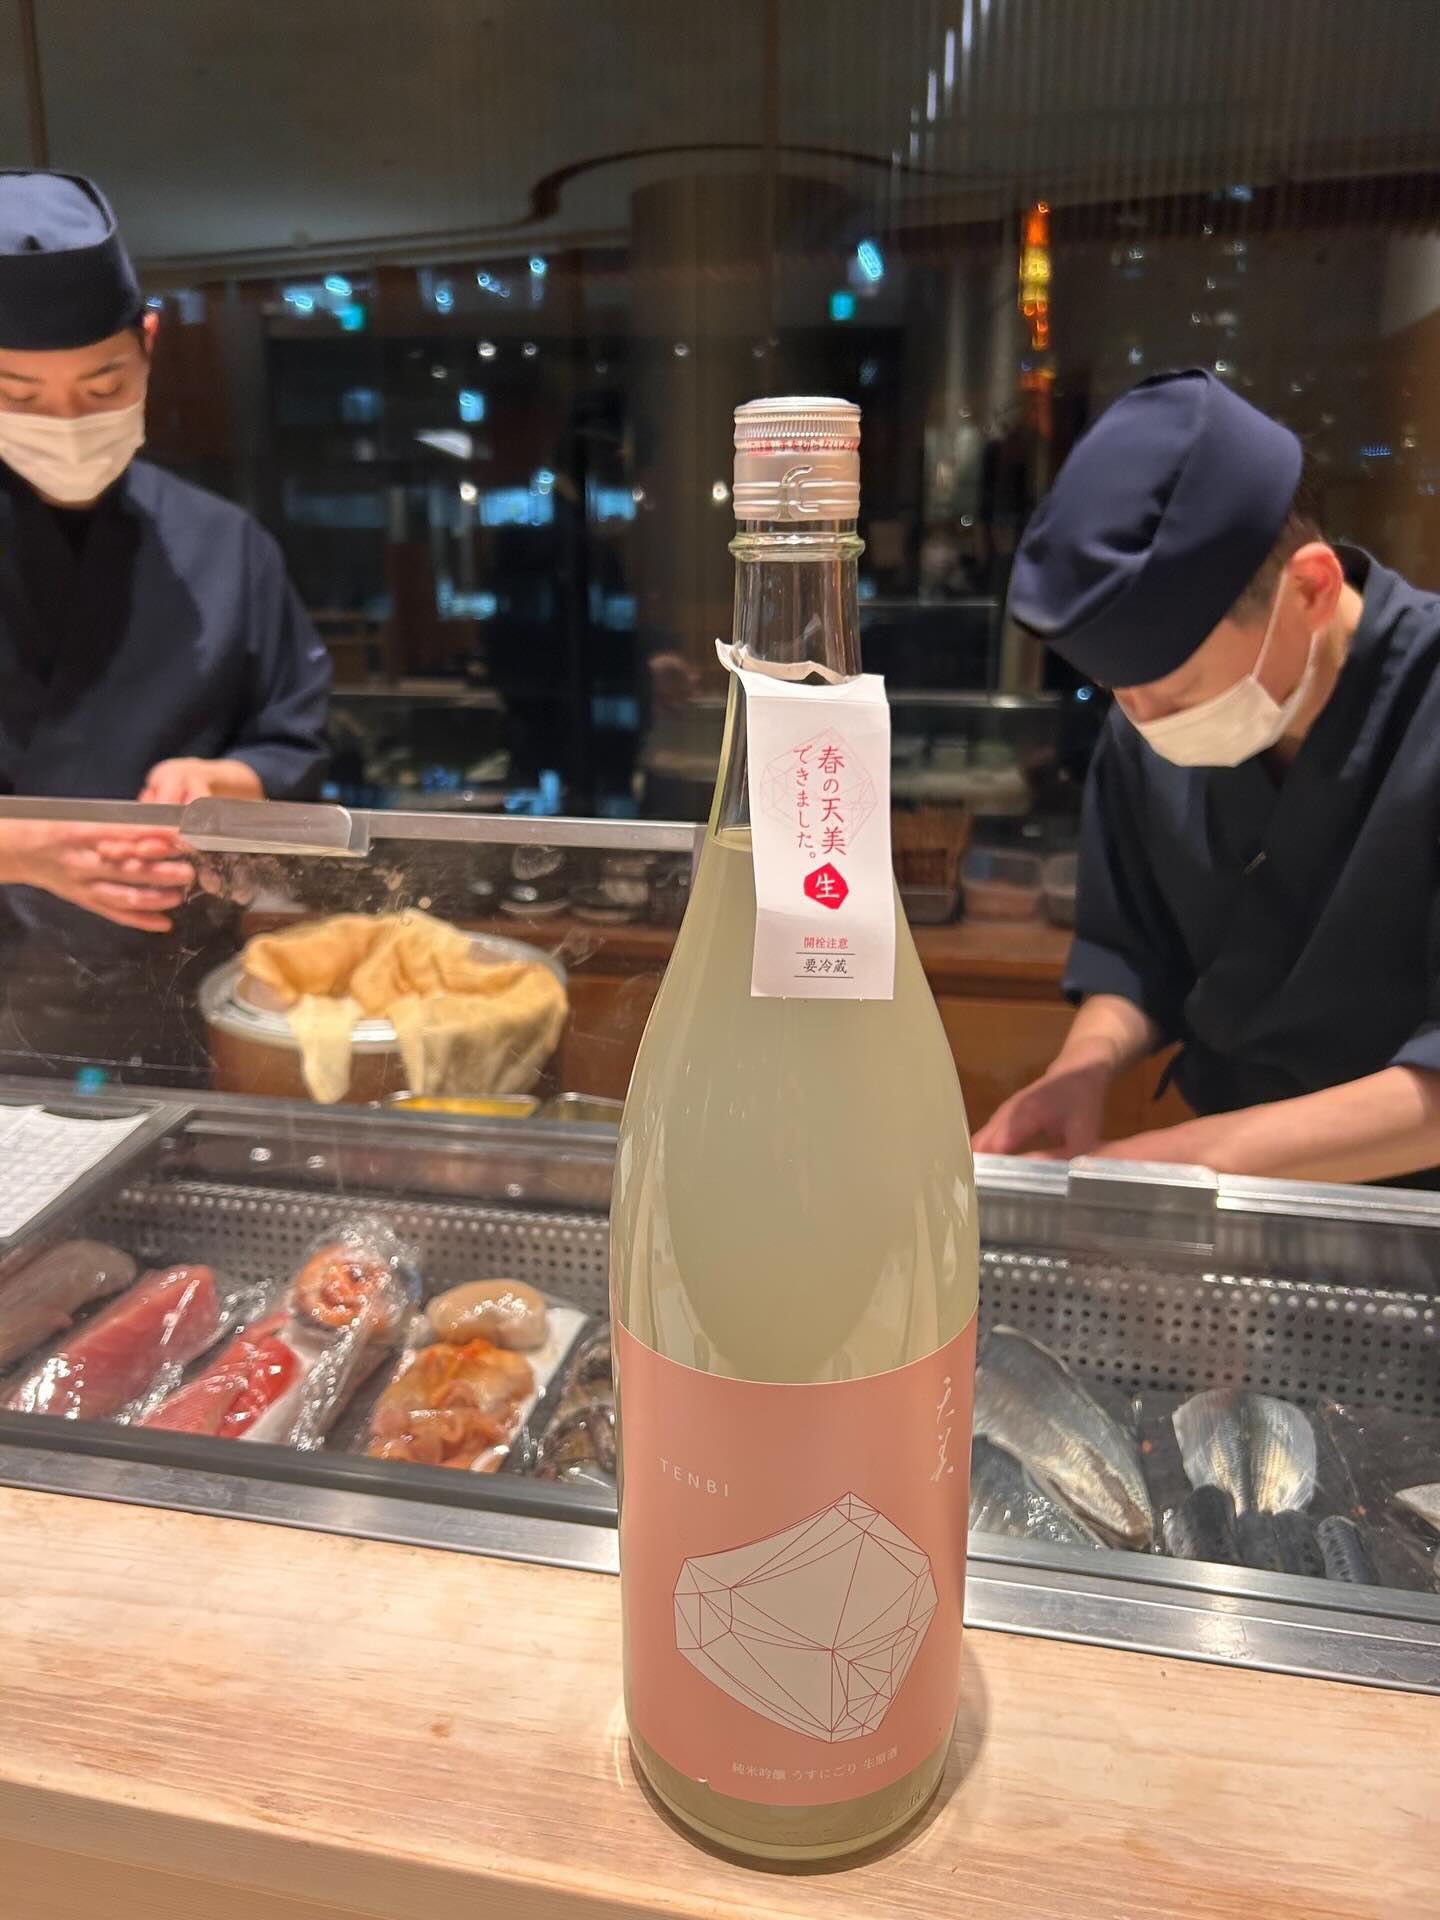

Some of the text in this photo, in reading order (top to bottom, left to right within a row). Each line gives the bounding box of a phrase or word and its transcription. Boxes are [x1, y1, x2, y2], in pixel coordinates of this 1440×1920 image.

[793, 745, 816, 859] できました。
[818, 745, 847, 856] 春の天美
[815, 872, 840, 899] 生
[803, 936, 849, 950] 開栓注意
[803, 958, 848, 975] 要冷蔵
[659, 1457, 729, 1497] TENBI
[792, 1763, 857, 1781] うすにごり
